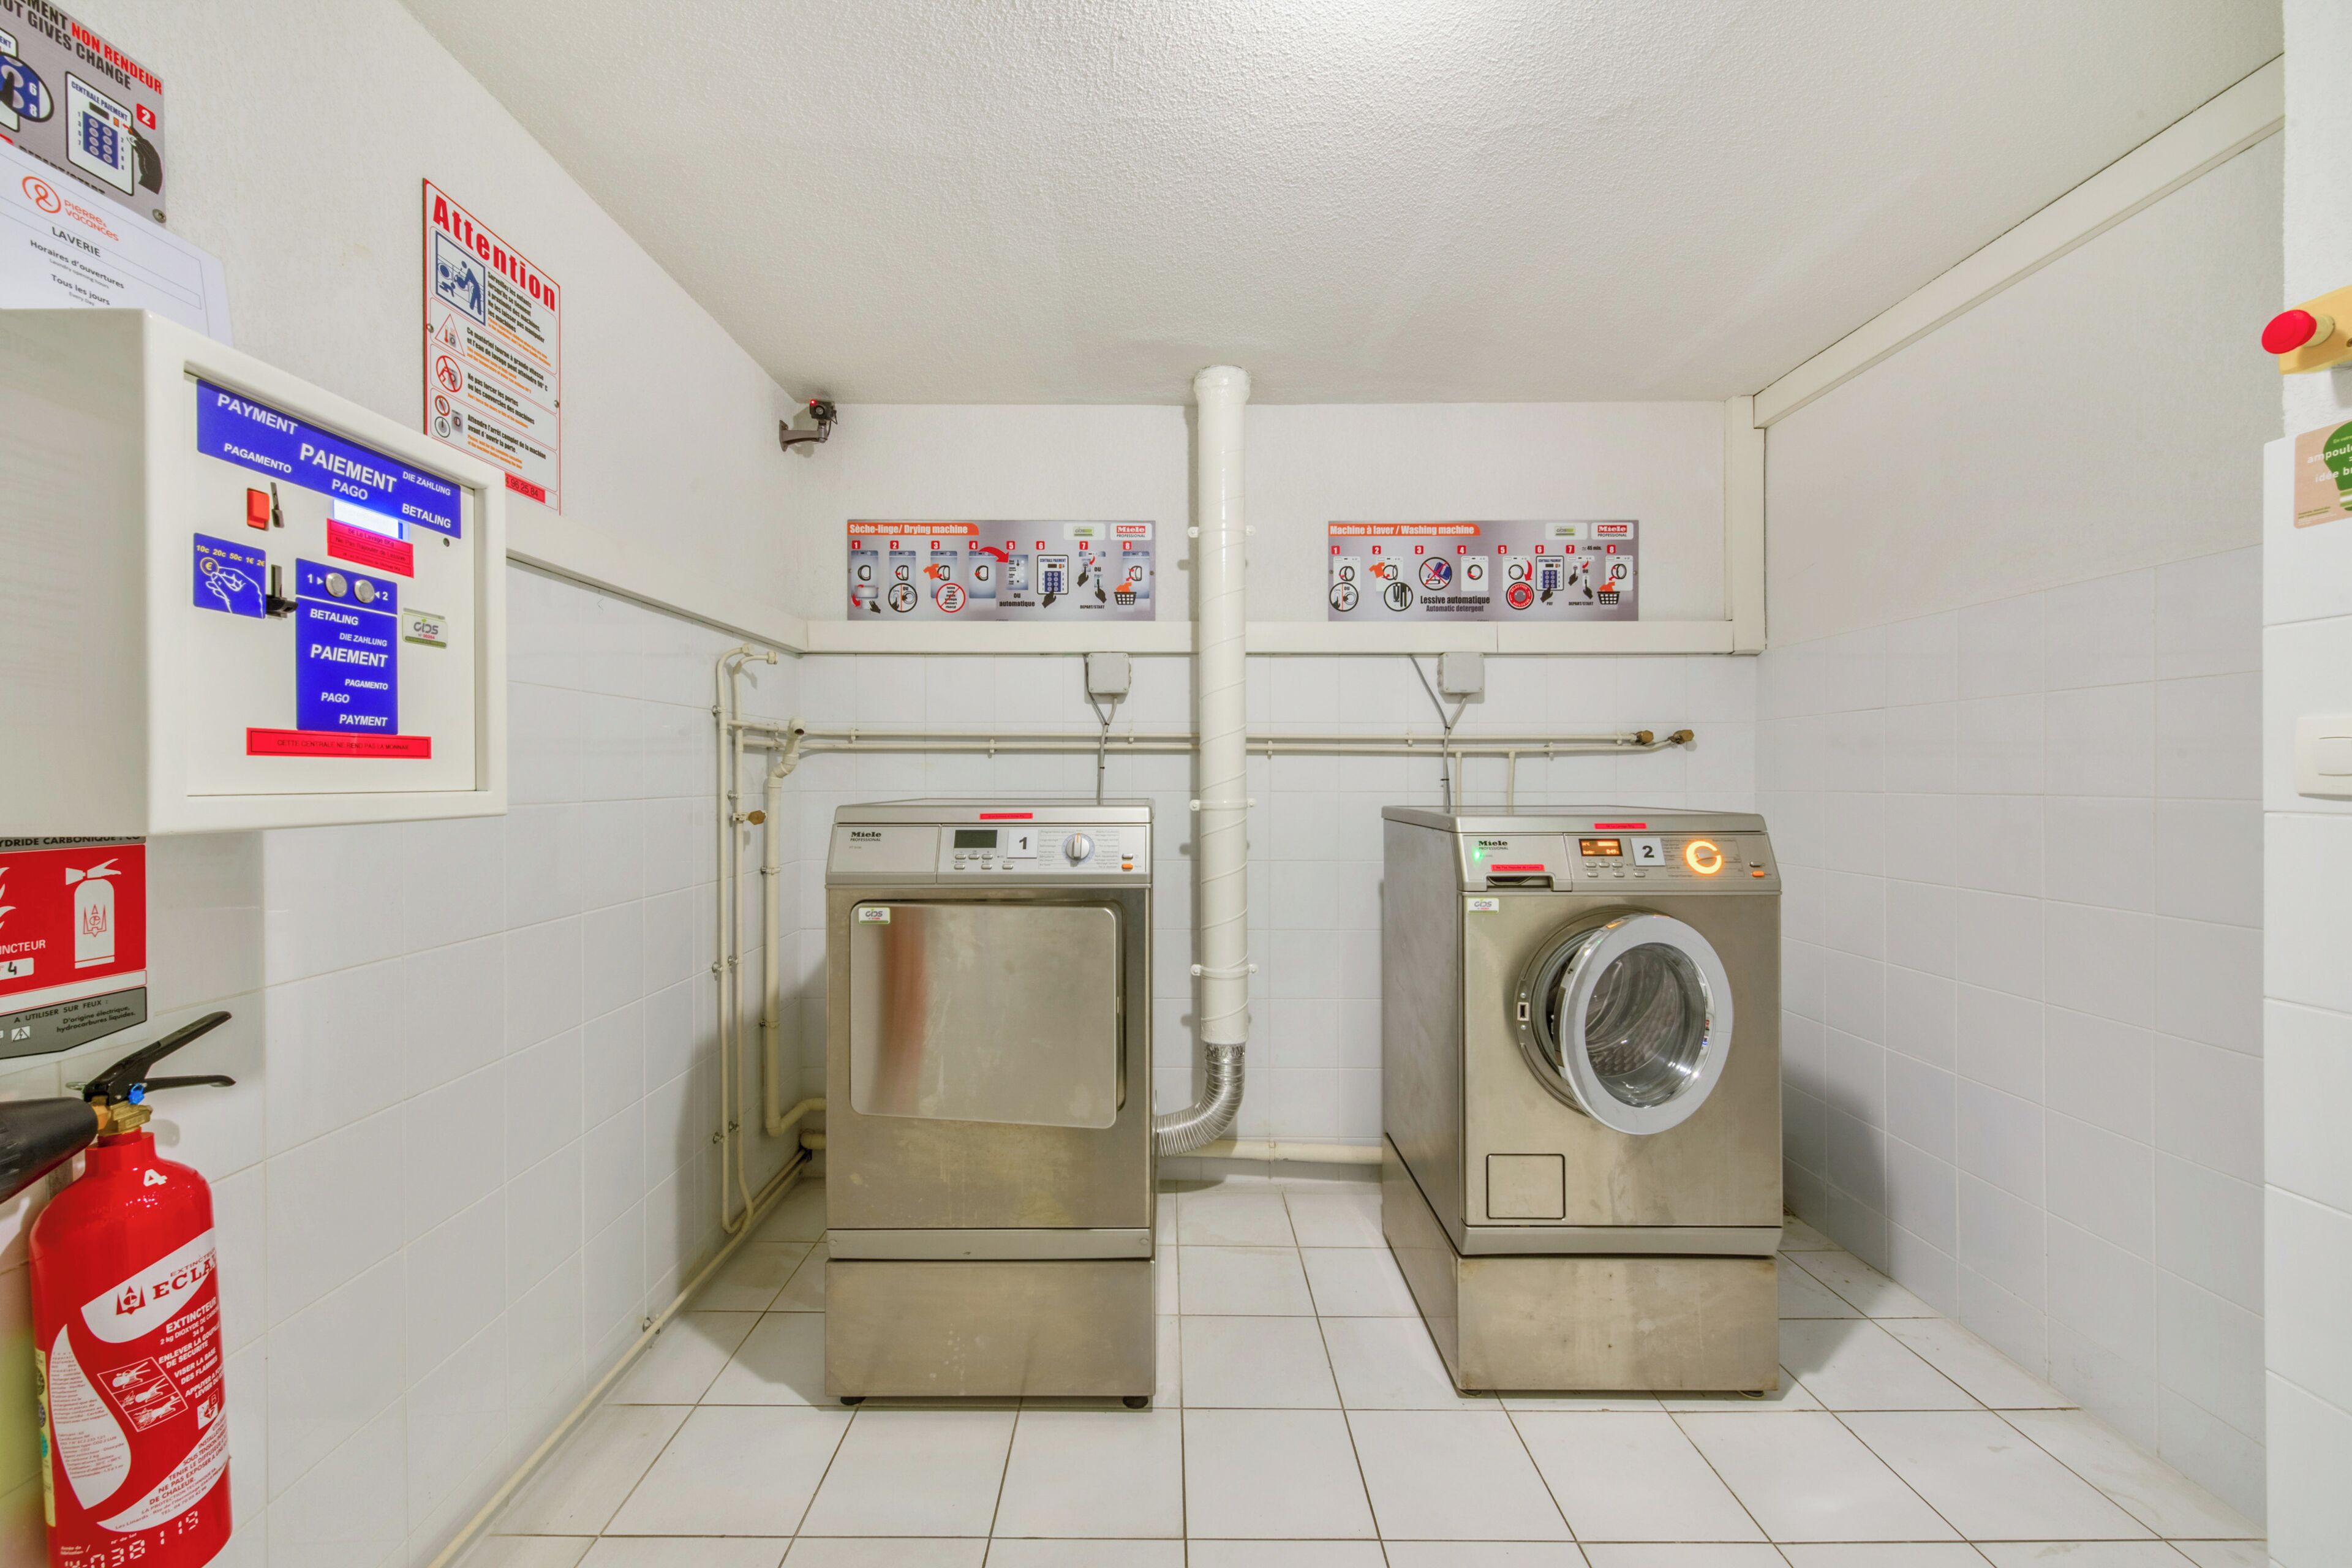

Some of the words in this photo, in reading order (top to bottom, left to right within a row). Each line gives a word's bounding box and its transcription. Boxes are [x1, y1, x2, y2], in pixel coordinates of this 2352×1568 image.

[28, 10, 72, 51] GIVES
[76, 42, 131, 90] CHANGE
[70, 21, 100, 53] NON
[104, 44, 162, 95] RENDEUR
[71, 80, 100, 104] CENTRALE
[100, 99, 128, 121] PAIEMENT
[141, 109, 151, 125] 2
[31, 239, 69, 263] Horaires
[52, 227, 100, 257] LAVERIE
[432, 194, 555, 312] Attention
[51, 274, 72, 289] Tous
[75, 284, 87, 295] les
[89, 291, 110, 305] jours
[217, 393, 298, 435] PAYMENT
[224, 443, 292, 473] PAGAMENTO
[300, 443, 397, 492] PAIEMENT
[402, 471, 415, 482] DIE
[416, 477, 451, 496] ZAHLUNG
[2315, 470, 2339, 483] idée
[331, 479, 368, 500] PAGO
[510, 478, 519, 489] 96
[521, 483, 529, 493] 25
[530, 488, 538, 497] 84
[402, 503, 451, 529] BETALING
[850, 524, 902, 534] Sèche-linge/
[904, 525, 930, 535] Drying
[932, 525, 968, 533] machine
[1330, 526, 1366, 534] Machine
[1367, 526, 1372, 535] à
[1374, 526, 1395, 535] laver
[1401, 526, 1437, 535] Washing
[1439, 526, 1474, 534] machine
[197, 545, 209, 553] 10c
[213, 549, 226, 557] 20c
[229, 552, 243, 561] 50c
[307, 574, 313, 584] 1
[382, 592, 388, 601] 2
[1447, 596, 1490, 605] automatique
[310, 608, 359, 625] BETALING
[353, 635, 388, 647] ZAHLUNG
[311, 644, 388, 668] PAIEMENT
[345, 679, 388, 690] PAGAMENTO
[321, 692, 350, 703] PAGO
[339, 714, 388, 726] PAYMENT
[1019, 837, 1027, 850] 1
[1642, 845, 1654, 858] 2
[7, 961, 17, 975] 4
[25, 1009, 59, 1021] UTILISER
[83, 1000, 102, 1009] FEUX
[62, 1014, 94, 1025] D'origine
[56, 1018, 107, 1033] hydrocarbures
[108, 1012, 136, 1022] liquides.
[166, 1297, 216, 1333] EXTINCTEUR
[175, 1321, 199, 1340] DIOXYDE
[200, 1316, 206, 1325] DE
[159, 1341, 192, 1364] ENLEVER
[194, 1338, 202, 1346] LA
[166, 1359, 177, 1368] DE
[178, 1340, 208, 1363] SECURITE
[175, 1362, 195, 1378] VISER
[196, 1357, 204, 1366] LA
[205, 1347, 216, 1360] BASE
[181, 1373, 194, 1385] DES
[195, 1355, 217, 1376] FLAMMES
[158, 1485, 168, 1493] NE
[171, 1477, 184, 1487] PAS
[186, 1458, 211, 1478] EXPOSER
[168, 1467, 188, 1481] TENIR
